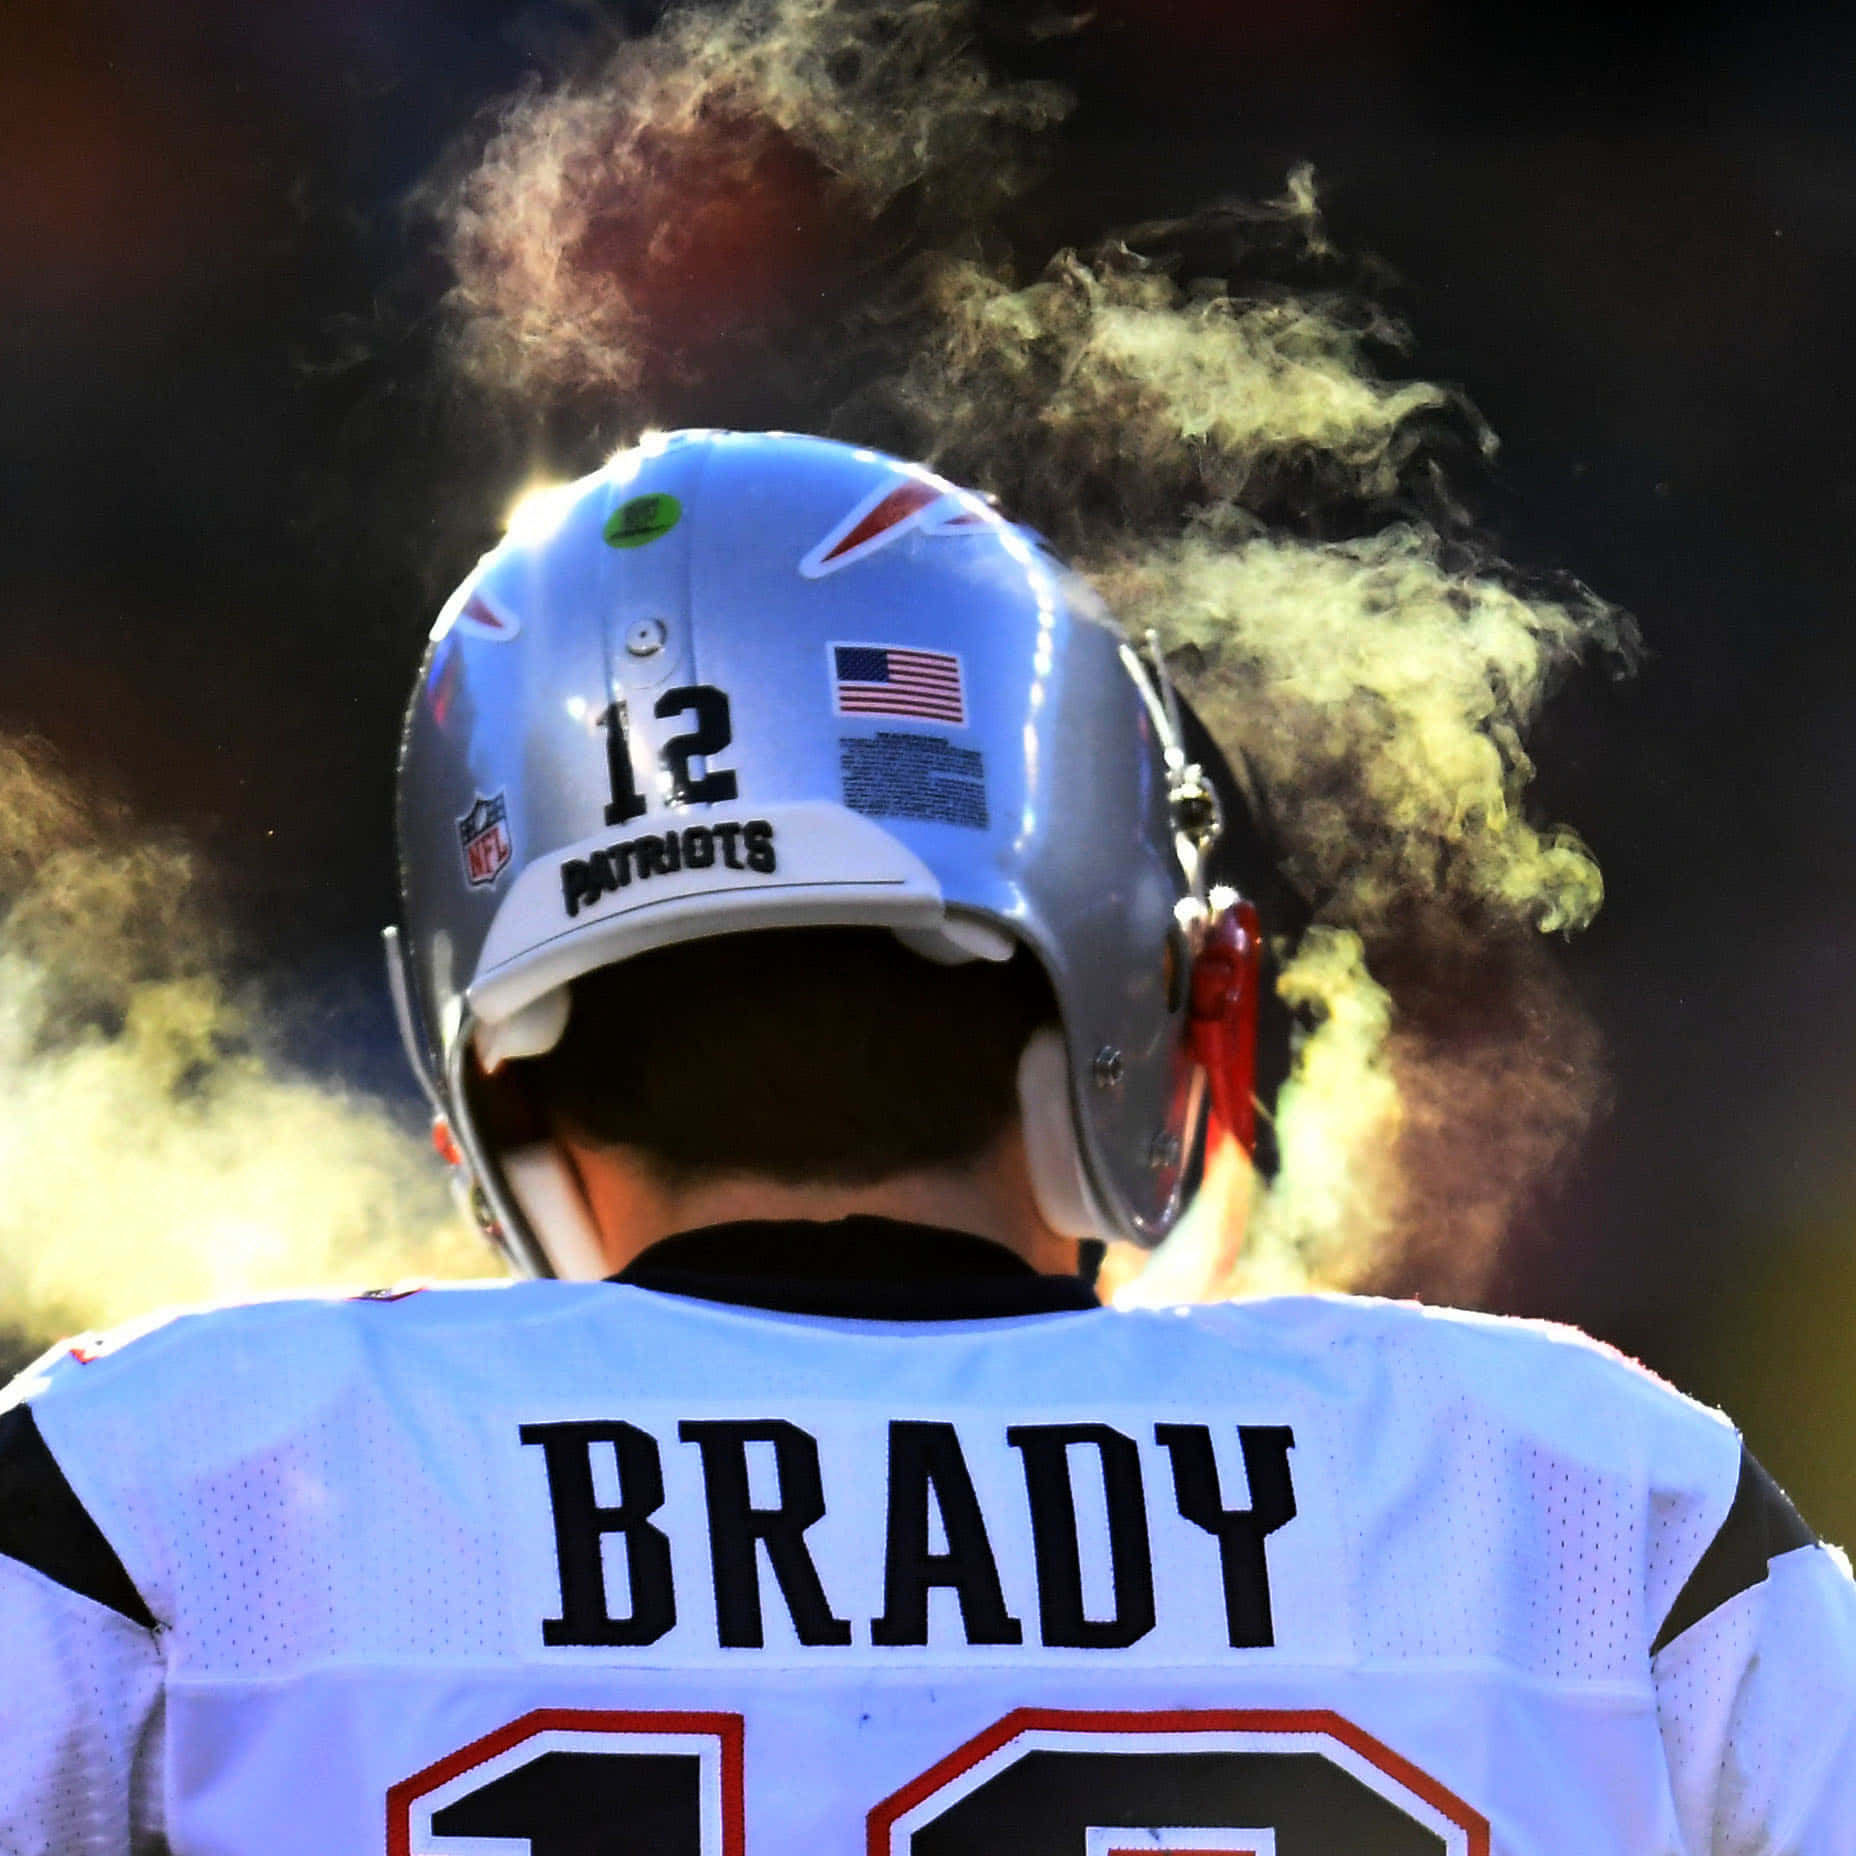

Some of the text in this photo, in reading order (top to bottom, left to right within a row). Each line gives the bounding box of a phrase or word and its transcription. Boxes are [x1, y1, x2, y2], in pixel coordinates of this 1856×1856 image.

[596, 684, 739, 827] 12
[468, 826, 509, 878] NFL
[560, 819, 777, 917] PATRIOTS
[519, 1418, 1298, 1650] BRADY
